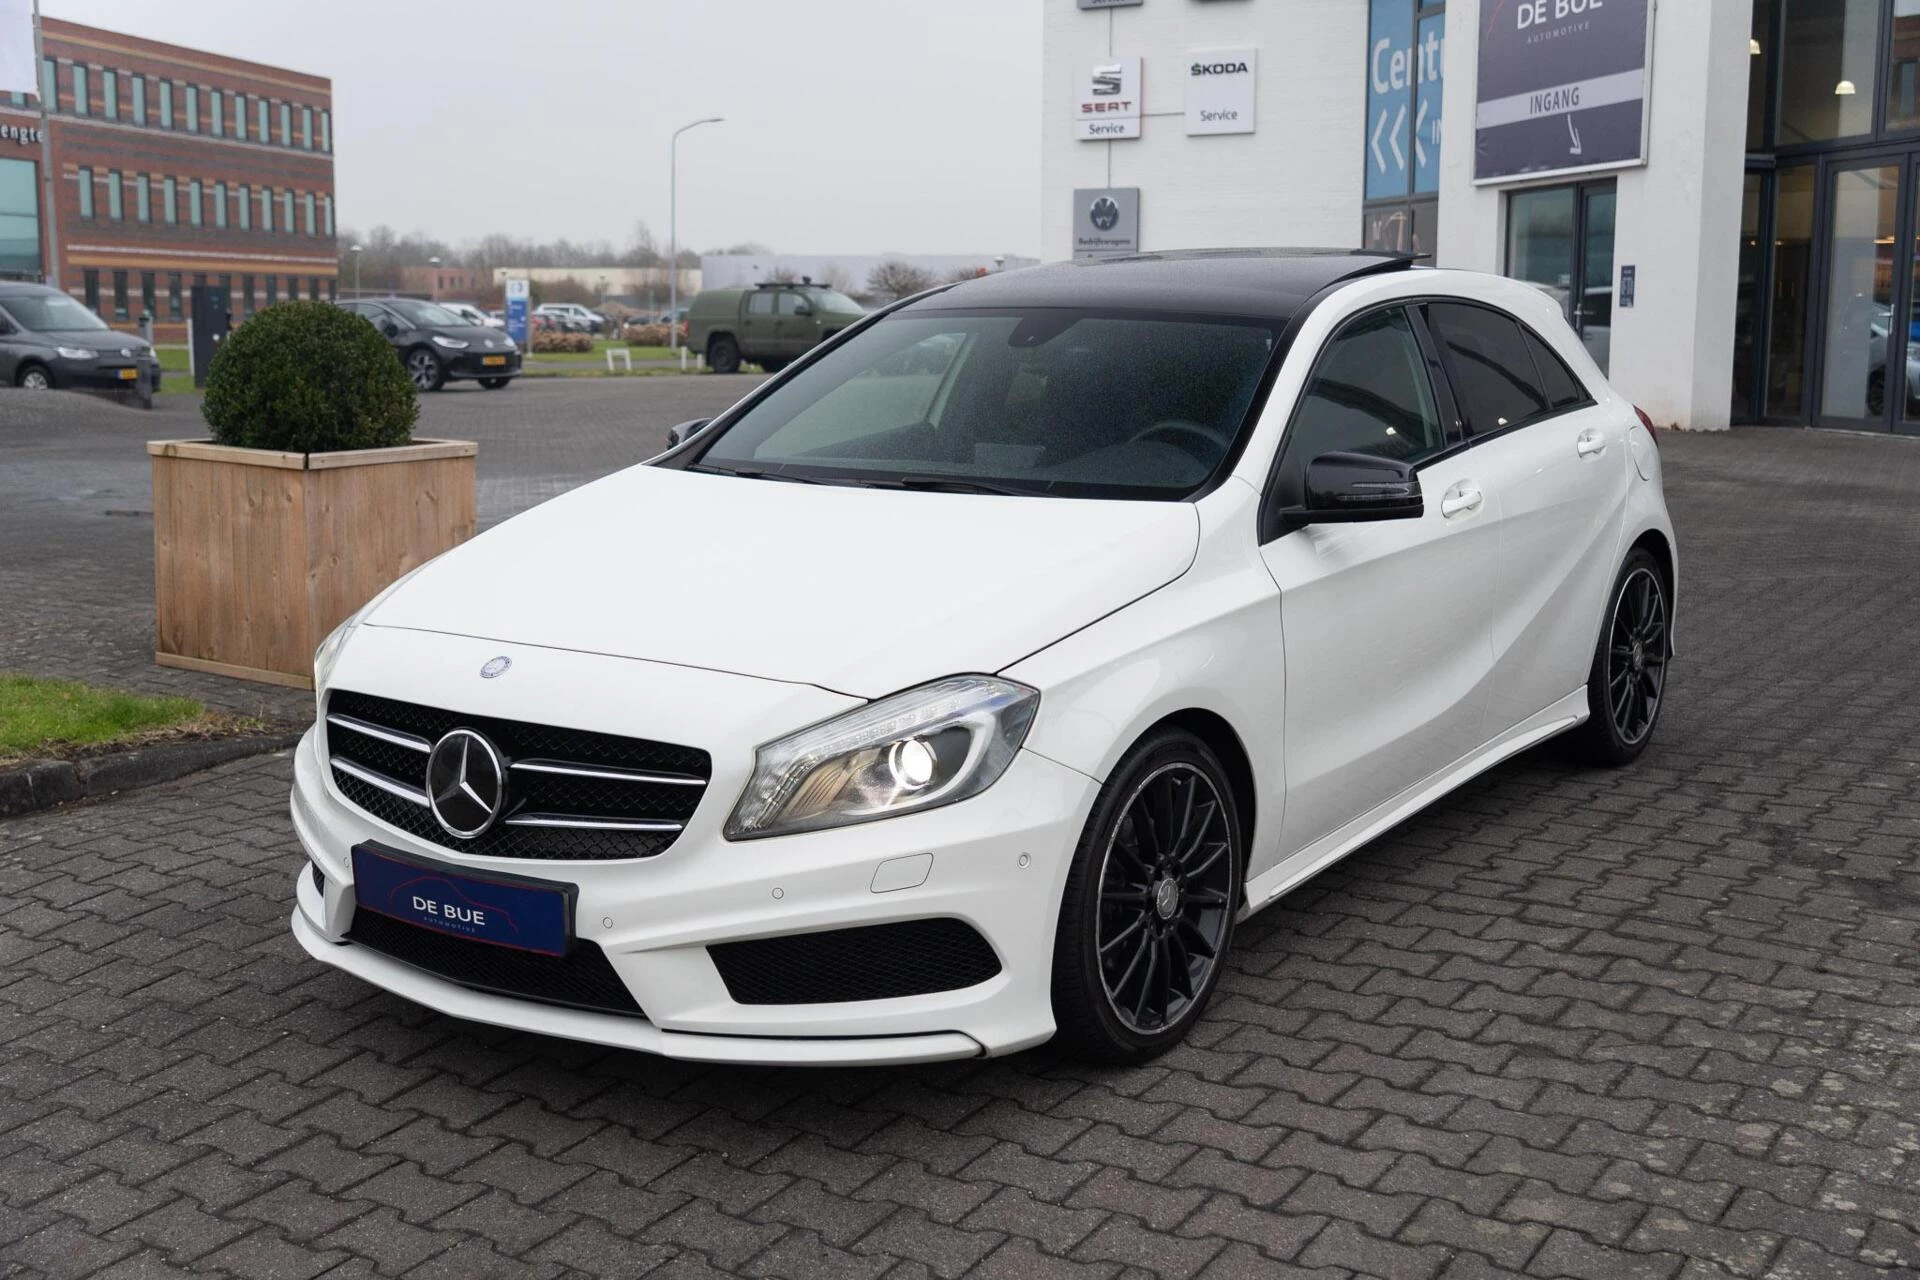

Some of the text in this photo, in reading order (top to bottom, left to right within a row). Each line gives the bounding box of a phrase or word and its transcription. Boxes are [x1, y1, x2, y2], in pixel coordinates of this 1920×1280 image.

[1517, 0, 1547, 29] DE
[1527, 21, 1590, 44] AUTOMOTIVE
[1191, 62, 1248, 76] ŠKODA
[1081, 101, 1132, 113] SEAT
[1530, 86, 1580, 115] INGANG
[1200, 109, 1238, 121] Service
[1089, 123, 1125, 135] Service
[412, 896, 485, 925] DE BUE
[423, 916, 476, 933] AUTOMOTIVE
